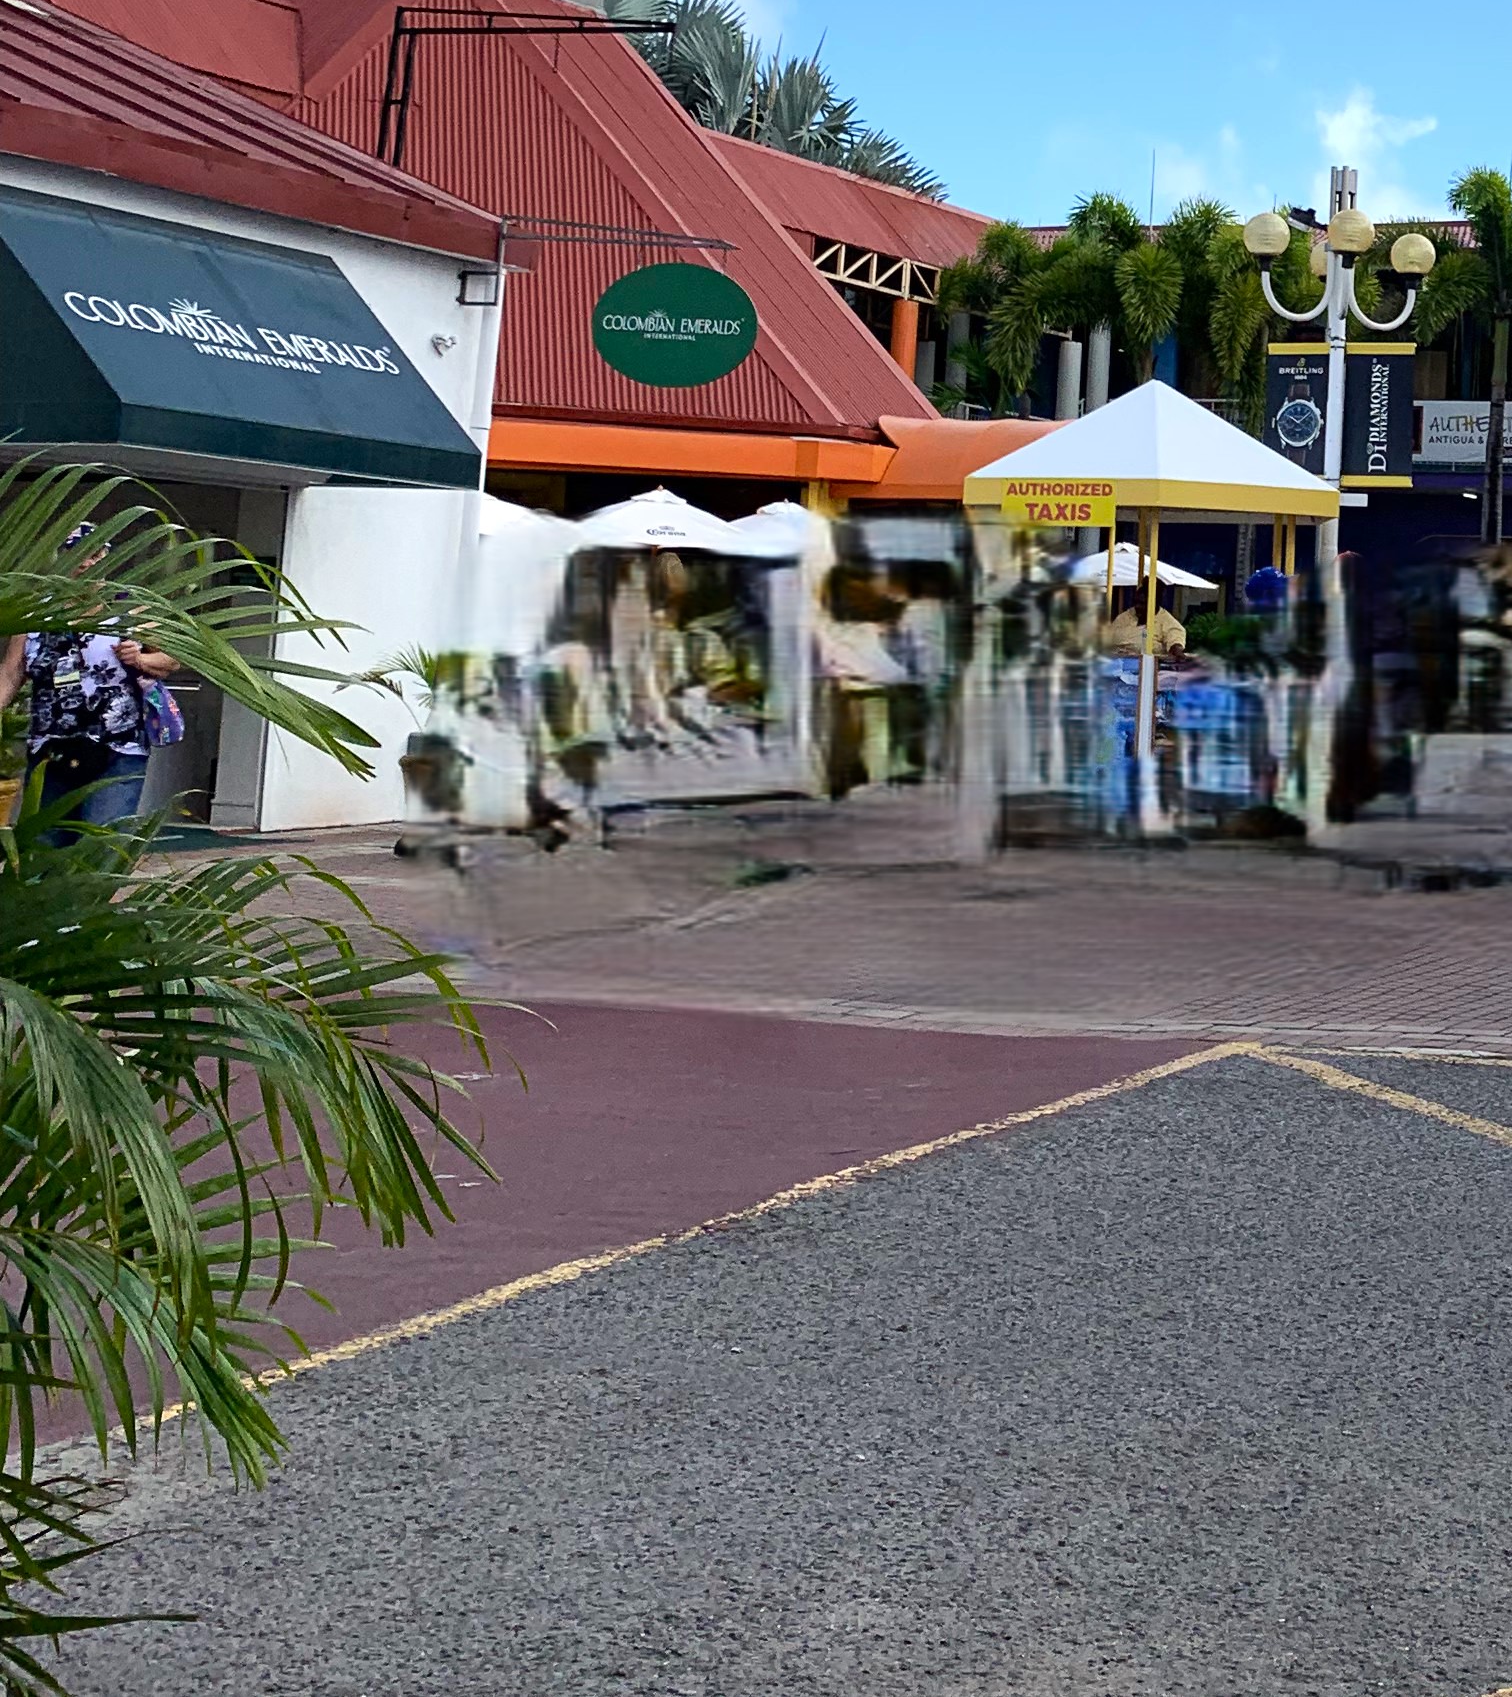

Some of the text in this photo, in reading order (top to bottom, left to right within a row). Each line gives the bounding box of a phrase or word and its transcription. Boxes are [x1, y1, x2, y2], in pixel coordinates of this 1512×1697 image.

[64, 291, 400, 375] COLOMBIAN EMERALDS
[602, 314, 740, 336] COLOMBIAN EMERALDS
[643, 333, 696, 341] INTERNATIONAL
[194, 342, 321, 374] INTERNATIONAL
[1278, 366, 1324, 375] BREITLING
[1368, 364, 1382, 442] DIAMONDS
[1379, 364, 1390, 442] INTERNATIONAL
[1428, 436, 1474, 444] ANTIGUA
[1477, 436, 1484, 444] &
[1006, 482, 1113, 496] AUTHORIZED
[1025, 502, 1091, 521] TAXIS
